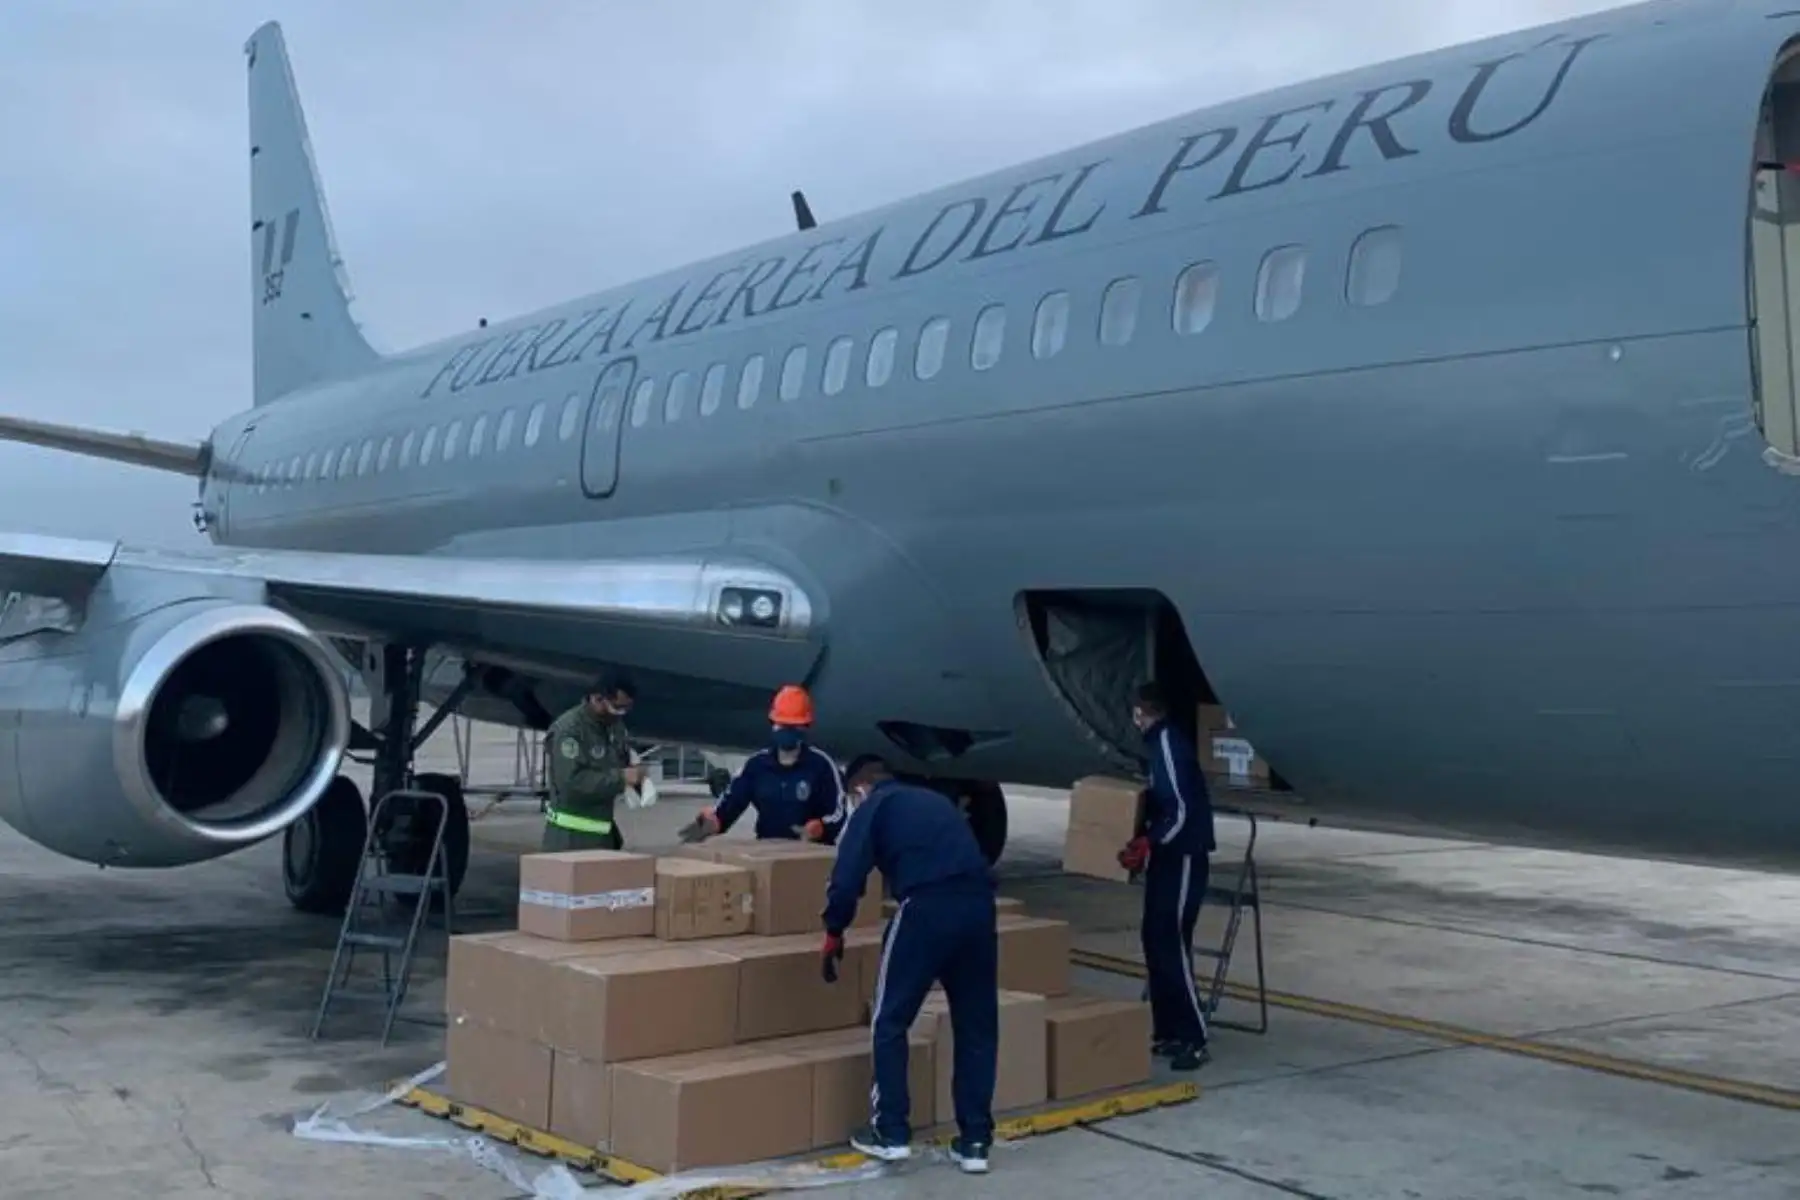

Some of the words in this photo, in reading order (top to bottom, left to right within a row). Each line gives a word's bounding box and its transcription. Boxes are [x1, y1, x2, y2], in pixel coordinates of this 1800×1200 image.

[421, 297, 635, 398] FUERZA
[890, 157, 1111, 280] DEL
[1128, 33, 1611, 220] PERÚ
